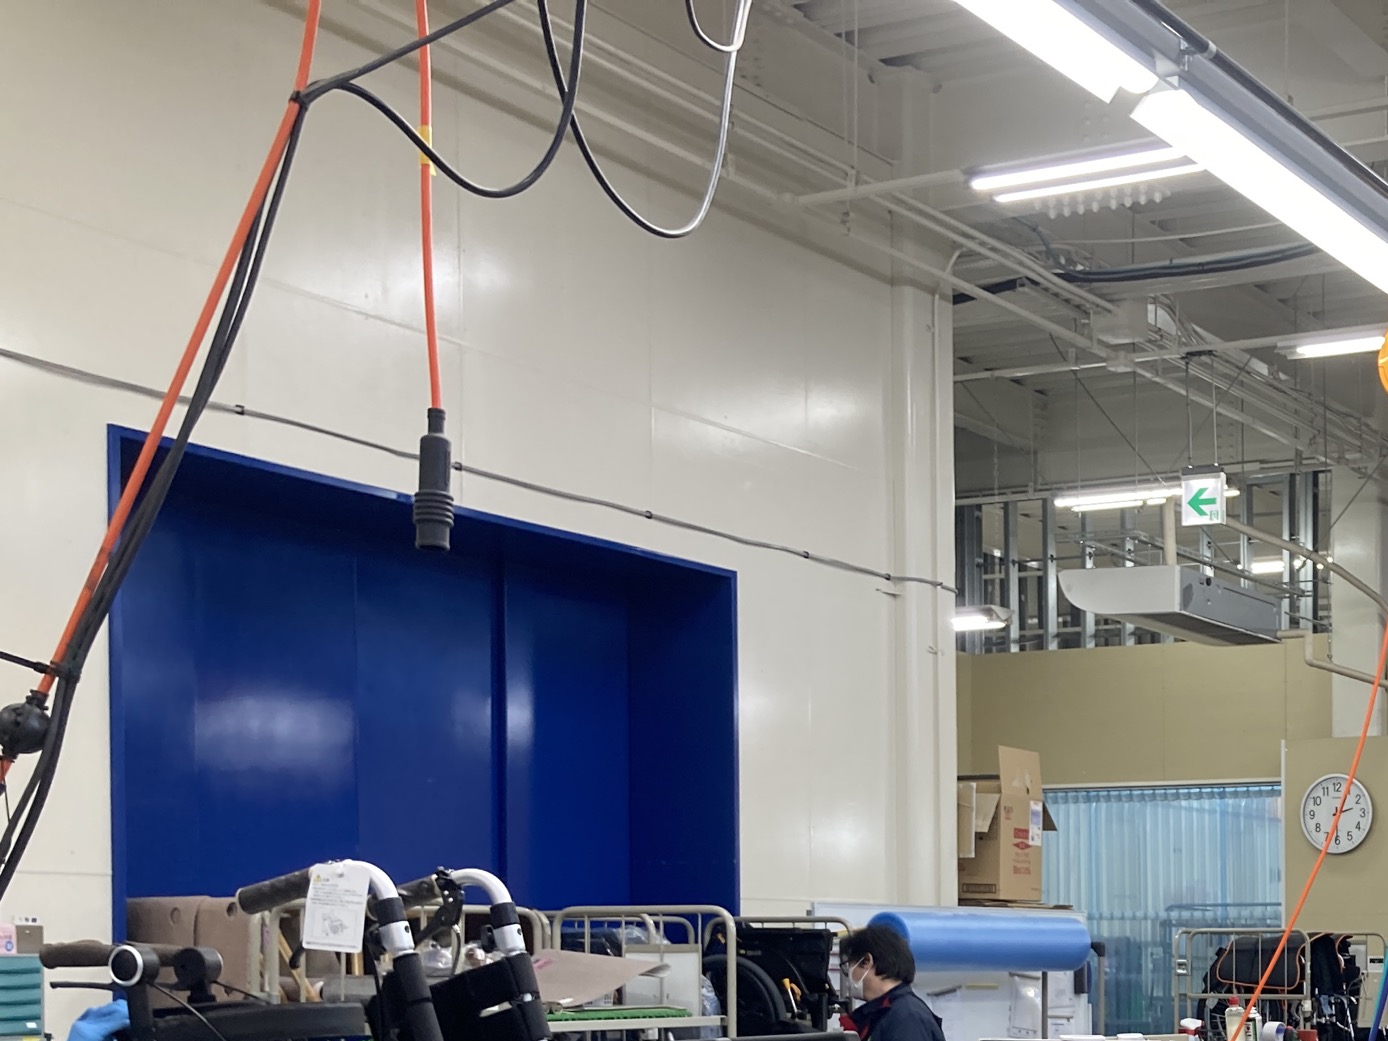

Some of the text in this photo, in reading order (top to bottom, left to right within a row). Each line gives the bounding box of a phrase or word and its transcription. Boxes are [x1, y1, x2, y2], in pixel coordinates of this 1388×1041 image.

[1322, 786, 1329, 796] 11
[1332, 782, 1342, 792] 12
[1312, 796, 1322, 806] 10
[1355, 794, 1361, 804] 2
[1309, 810, 1315, 820] 9
[1360, 808, 1366, 818] 3
[1315, 822, 1321, 832] 8
[1355, 821, 1361, 831] 4
[1334, 835, 1341, 845] 6
[1346, 831, 1353, 841] 5
